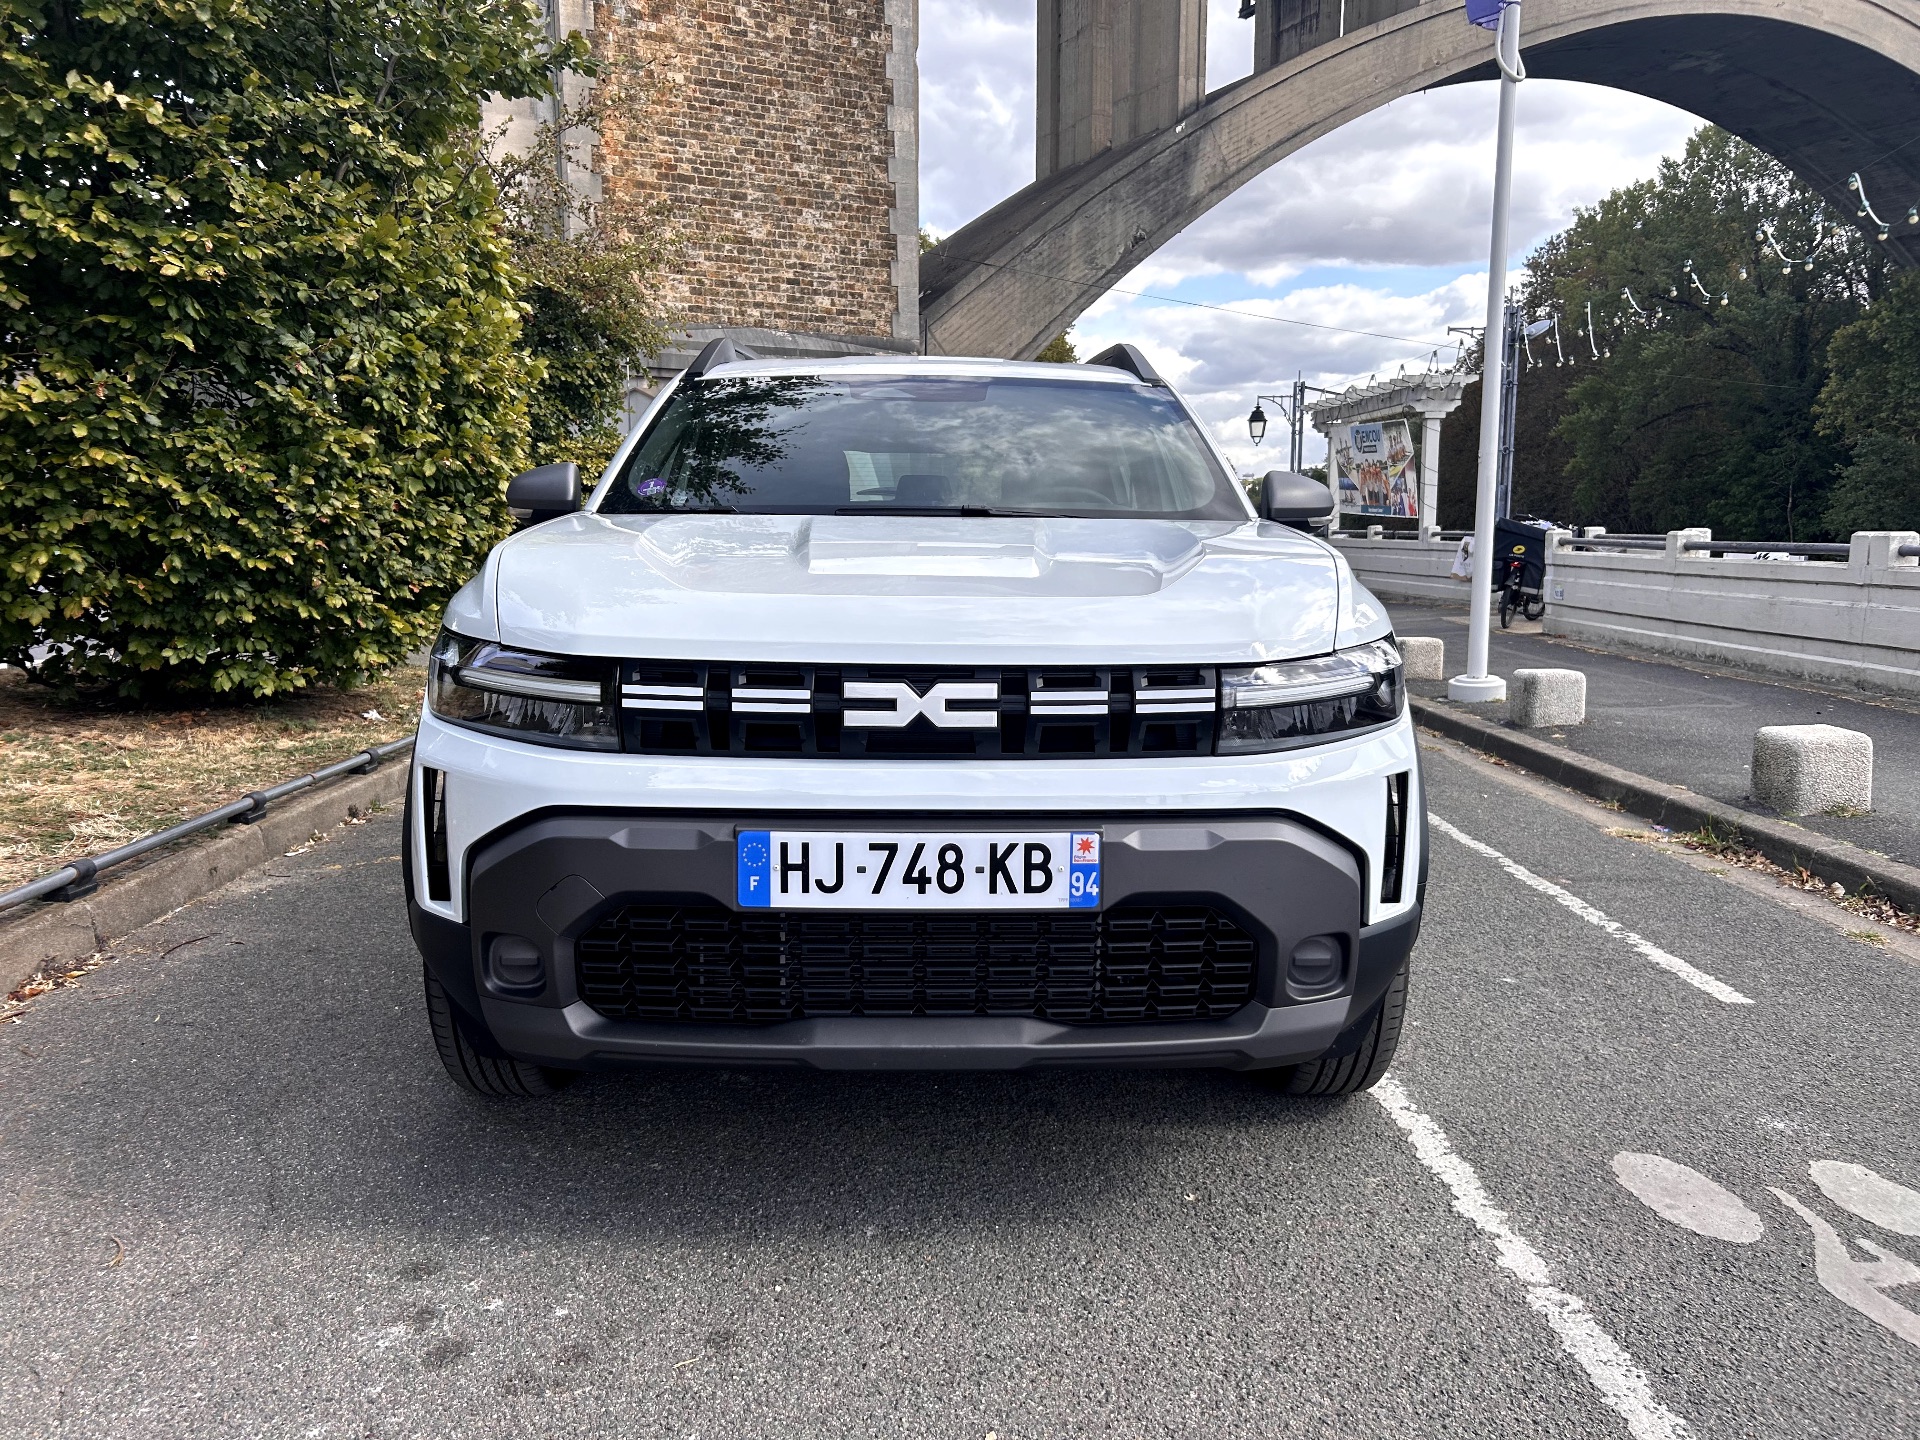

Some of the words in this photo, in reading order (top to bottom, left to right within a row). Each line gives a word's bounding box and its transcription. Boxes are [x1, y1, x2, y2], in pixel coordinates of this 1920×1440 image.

[779, 841, 1053, 895] HJ-748-KB
[750, 875, 760, 891] F
[1071, 871, 1099, 897] 94
